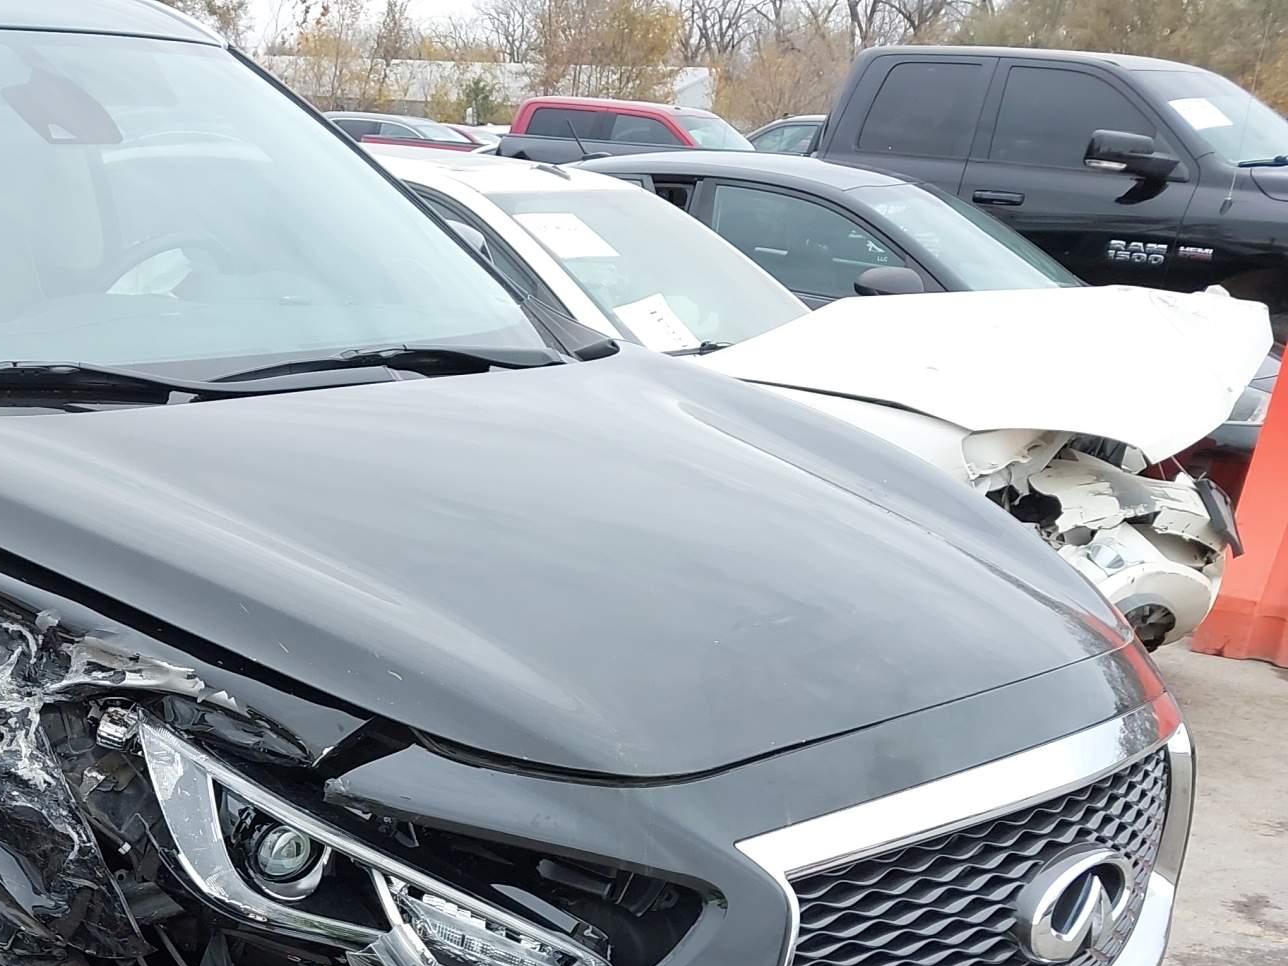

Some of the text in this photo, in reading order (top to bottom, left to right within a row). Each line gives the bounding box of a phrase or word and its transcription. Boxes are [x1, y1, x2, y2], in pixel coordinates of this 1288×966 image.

[1109, 239, 1169, 254] RAM
[1179, 246, 1214, 255] HEMI
[1107, 249, 1165, 265] 1500
